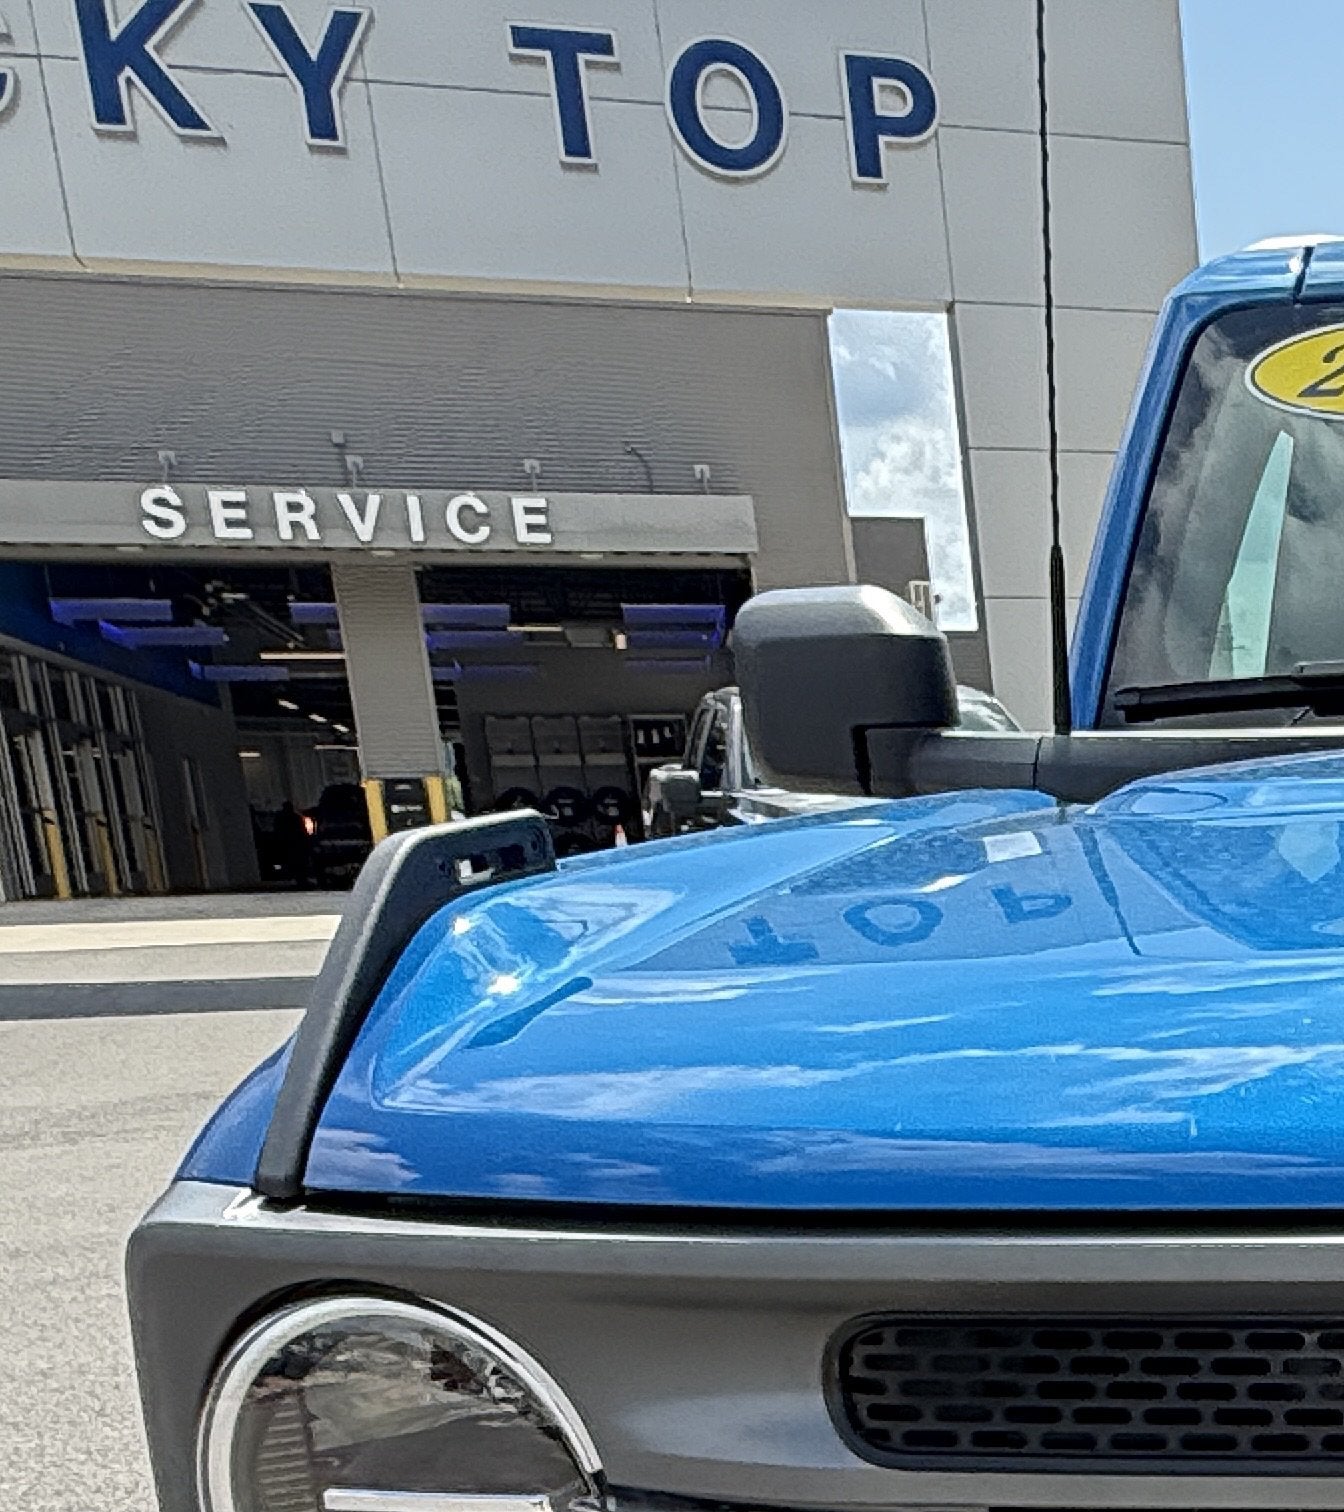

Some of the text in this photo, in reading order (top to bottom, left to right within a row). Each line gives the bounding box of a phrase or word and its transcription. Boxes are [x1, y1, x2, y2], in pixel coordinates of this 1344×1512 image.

[0, 0, 940, 186] KY TOP
[139, 485, 554, 545] SERVICE
